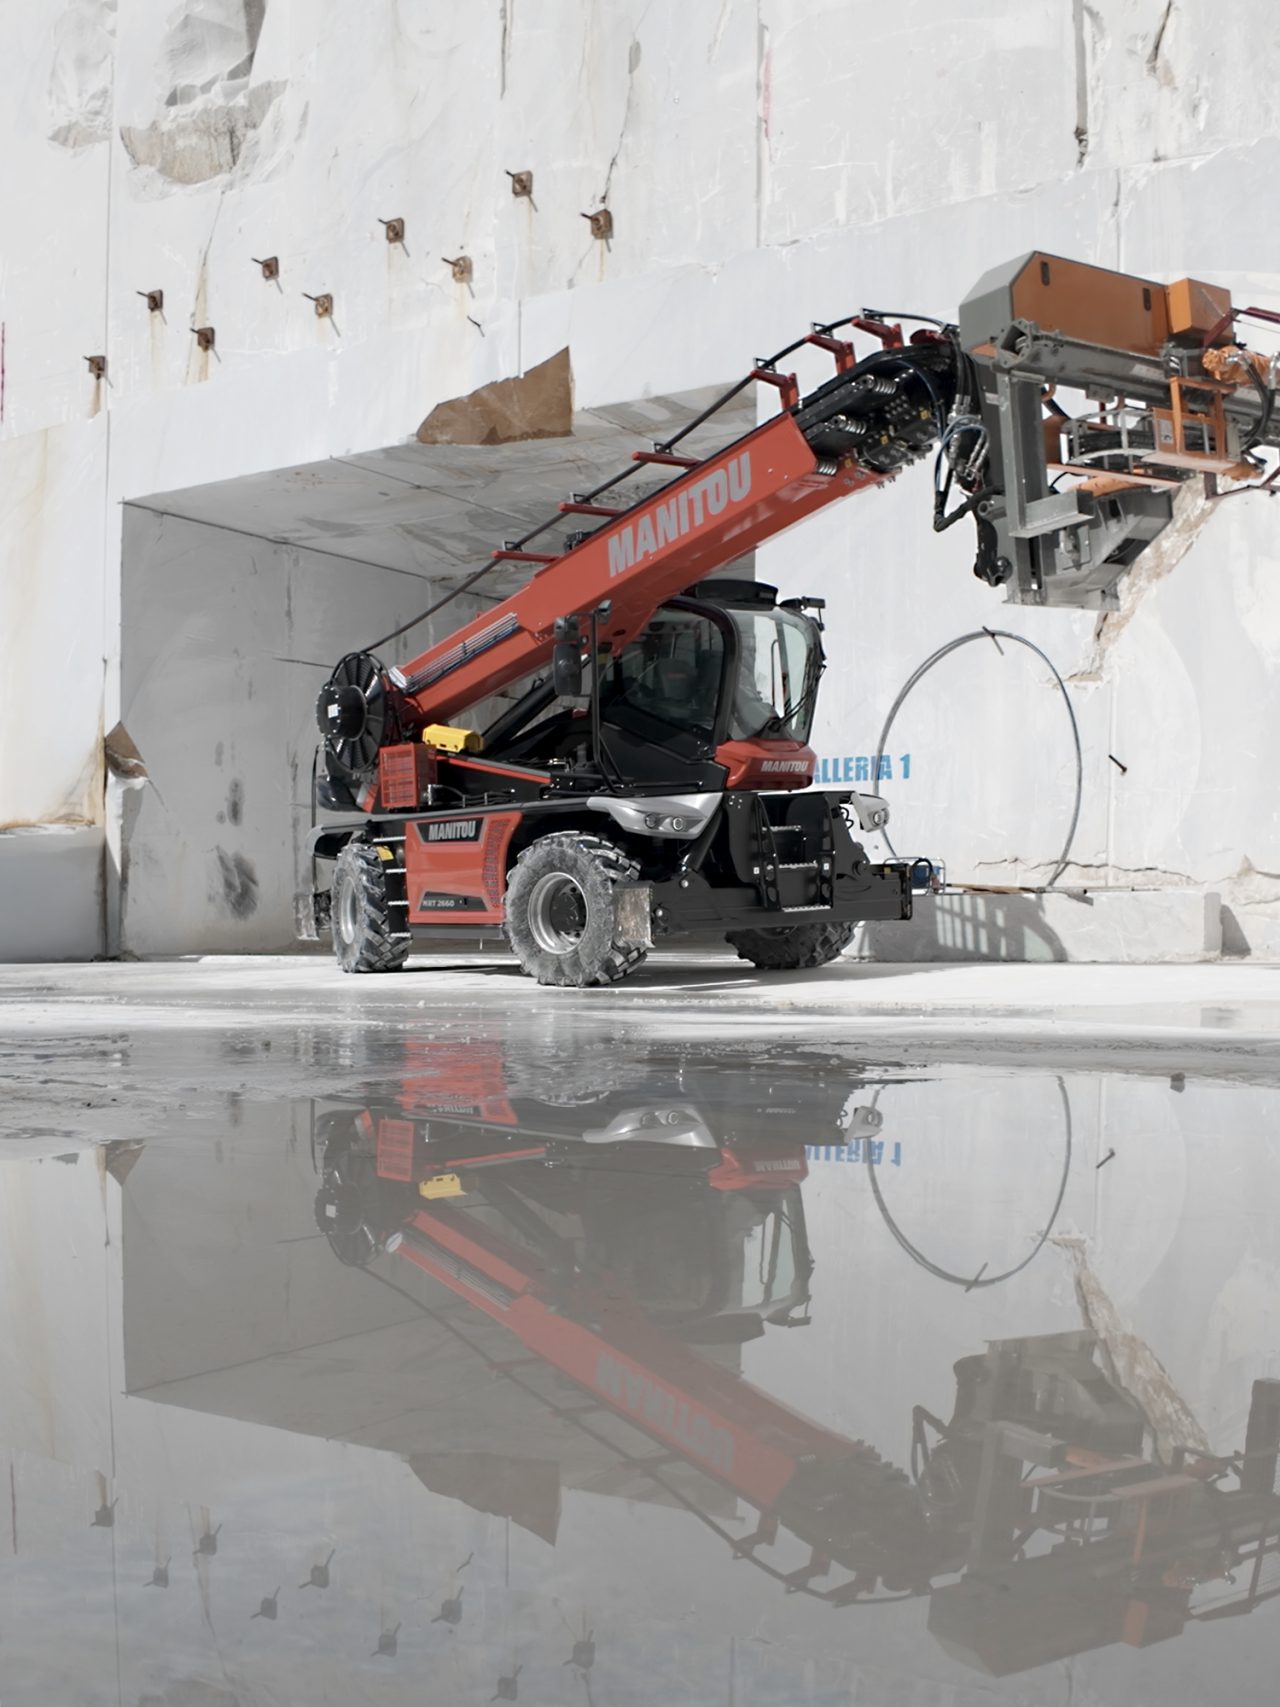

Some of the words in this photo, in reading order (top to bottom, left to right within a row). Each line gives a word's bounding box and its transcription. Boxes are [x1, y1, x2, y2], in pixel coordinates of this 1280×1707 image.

[608, 451, 751, 577] MANITOU
[761, 760, 809, 772] MANITOU
[900, 754, 911, 779] 1
[428, 820, 476, 840] MANITOU
